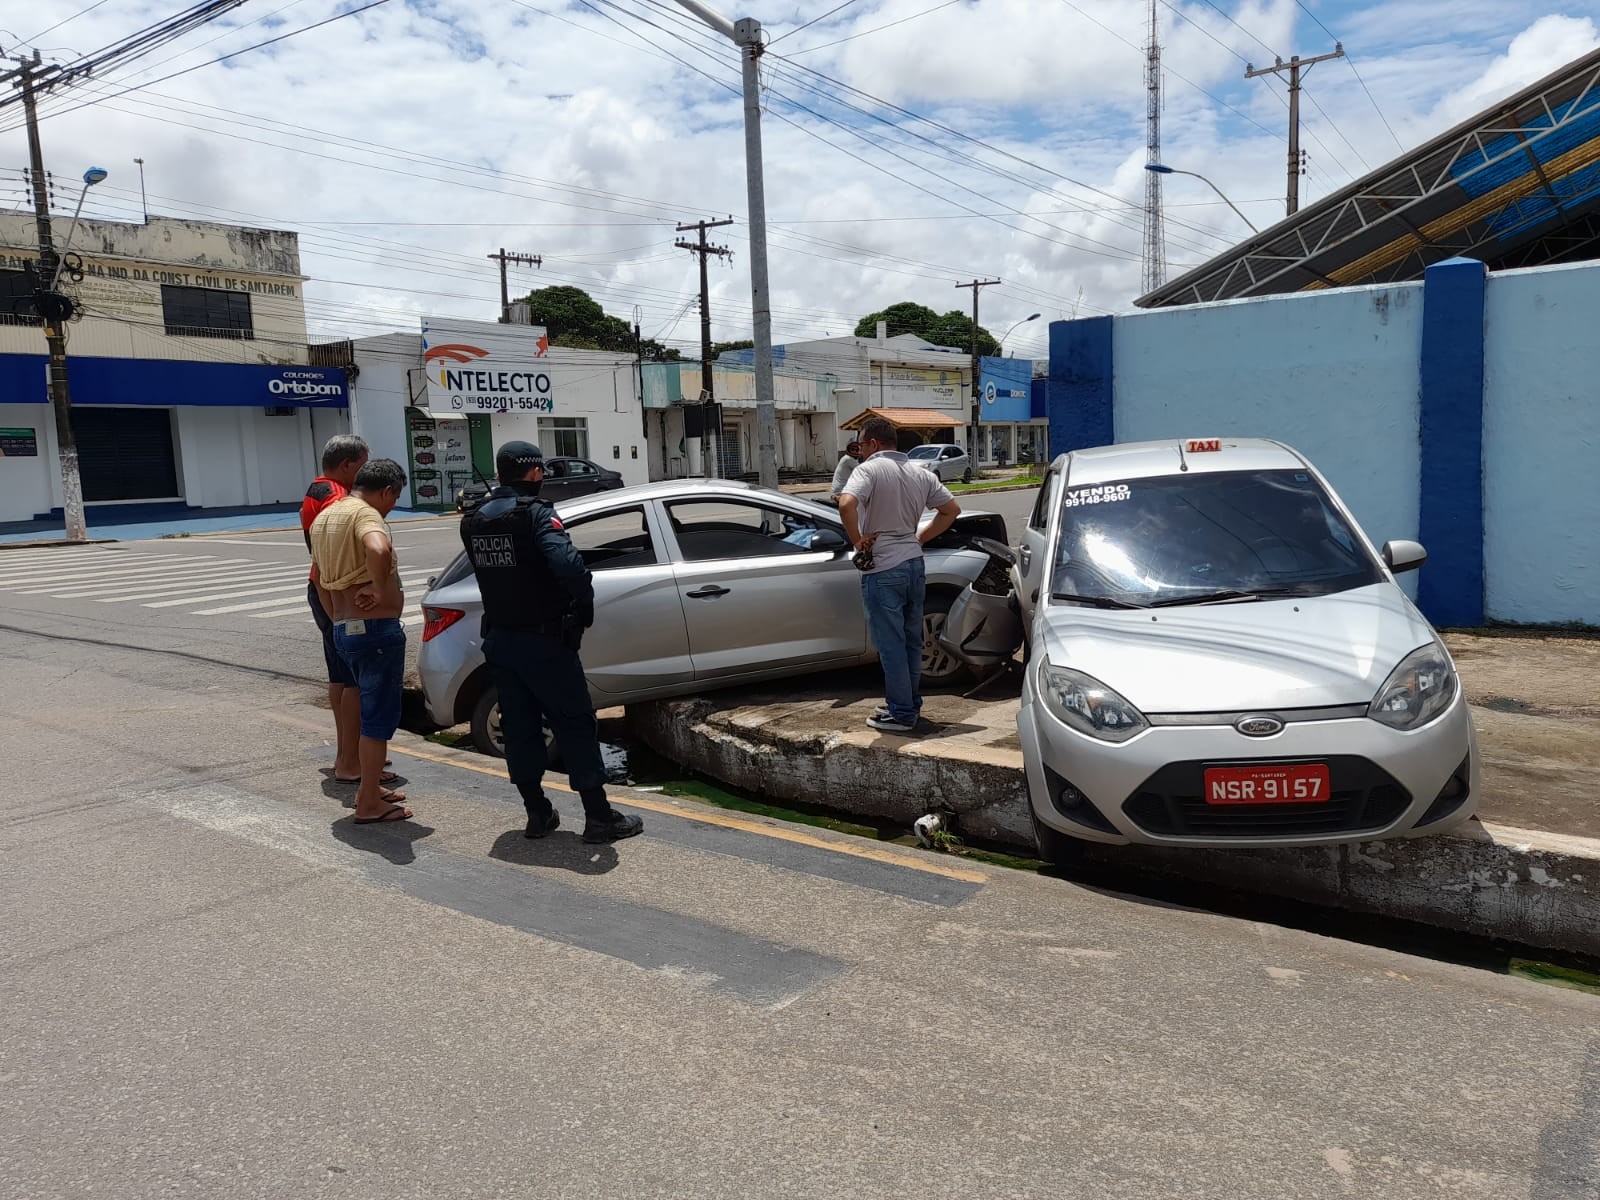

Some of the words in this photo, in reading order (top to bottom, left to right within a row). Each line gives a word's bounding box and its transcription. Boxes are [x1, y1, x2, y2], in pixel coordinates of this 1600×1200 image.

[88, 263, 104, 276] NA
[133, 268, 149, 281] DA
[195, 274, 222, 288] CIVIL
[225, 278, 238, 290] DE
[268, 379, 342, 395] Ortobom
[477, 396, 547, 409] 99201-5542
[1188, 440, 1220, 451] TAXI
[1067, 484, 1129, 499] VENDO
[1065, 491, 1131, 508] 99148-9607
[475, 551, 514, 566] MILITAR
